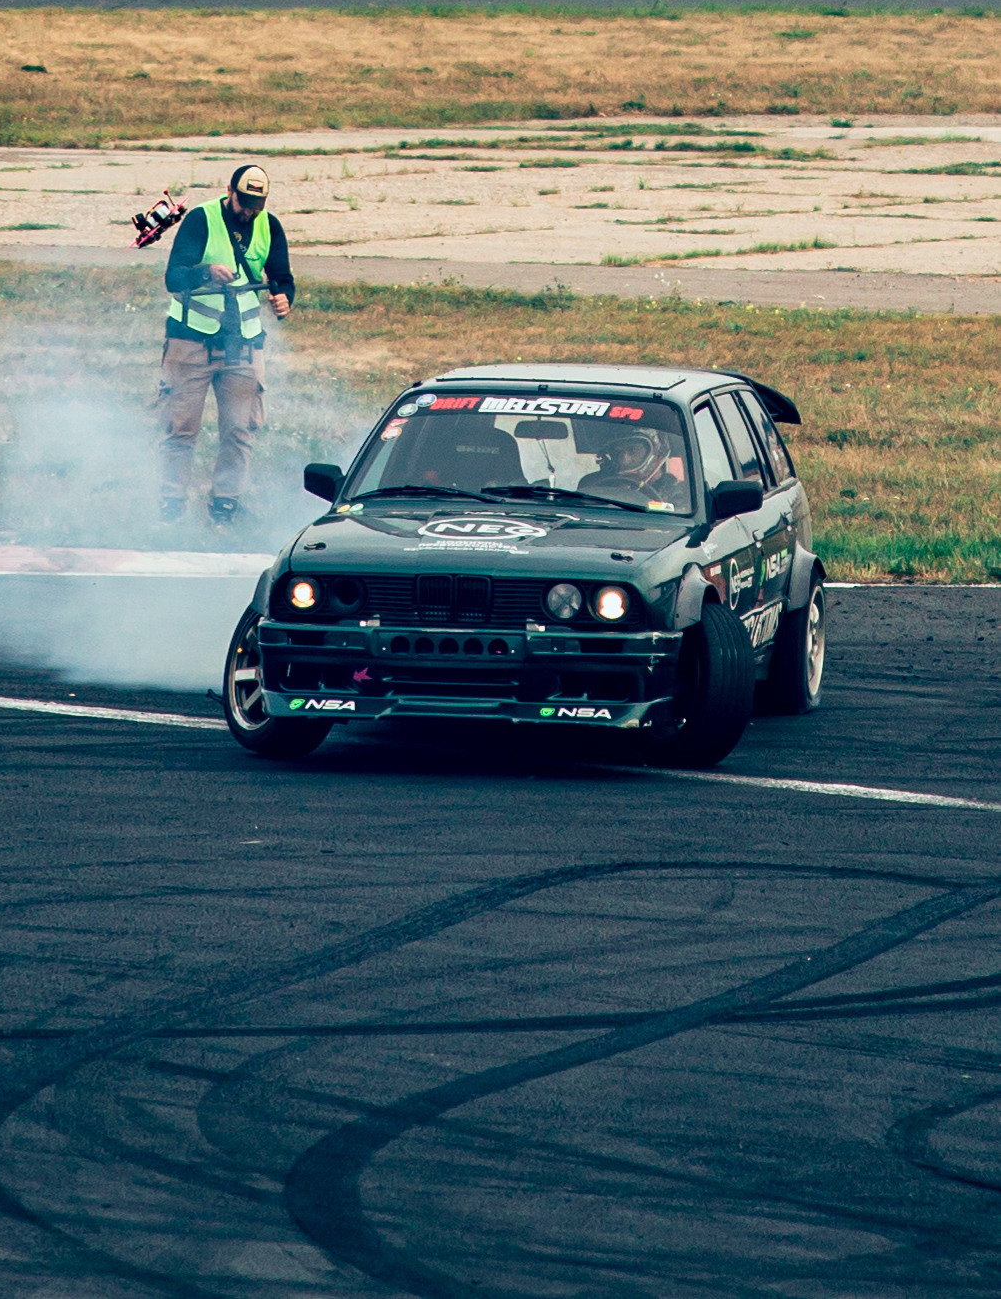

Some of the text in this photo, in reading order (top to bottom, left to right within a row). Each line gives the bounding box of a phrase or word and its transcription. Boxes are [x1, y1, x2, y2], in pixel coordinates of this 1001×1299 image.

[478, 397, 611, 417] MATSURI
[304, 699, 356, 711] NSA
[557, 707, 612, 720] NSA
